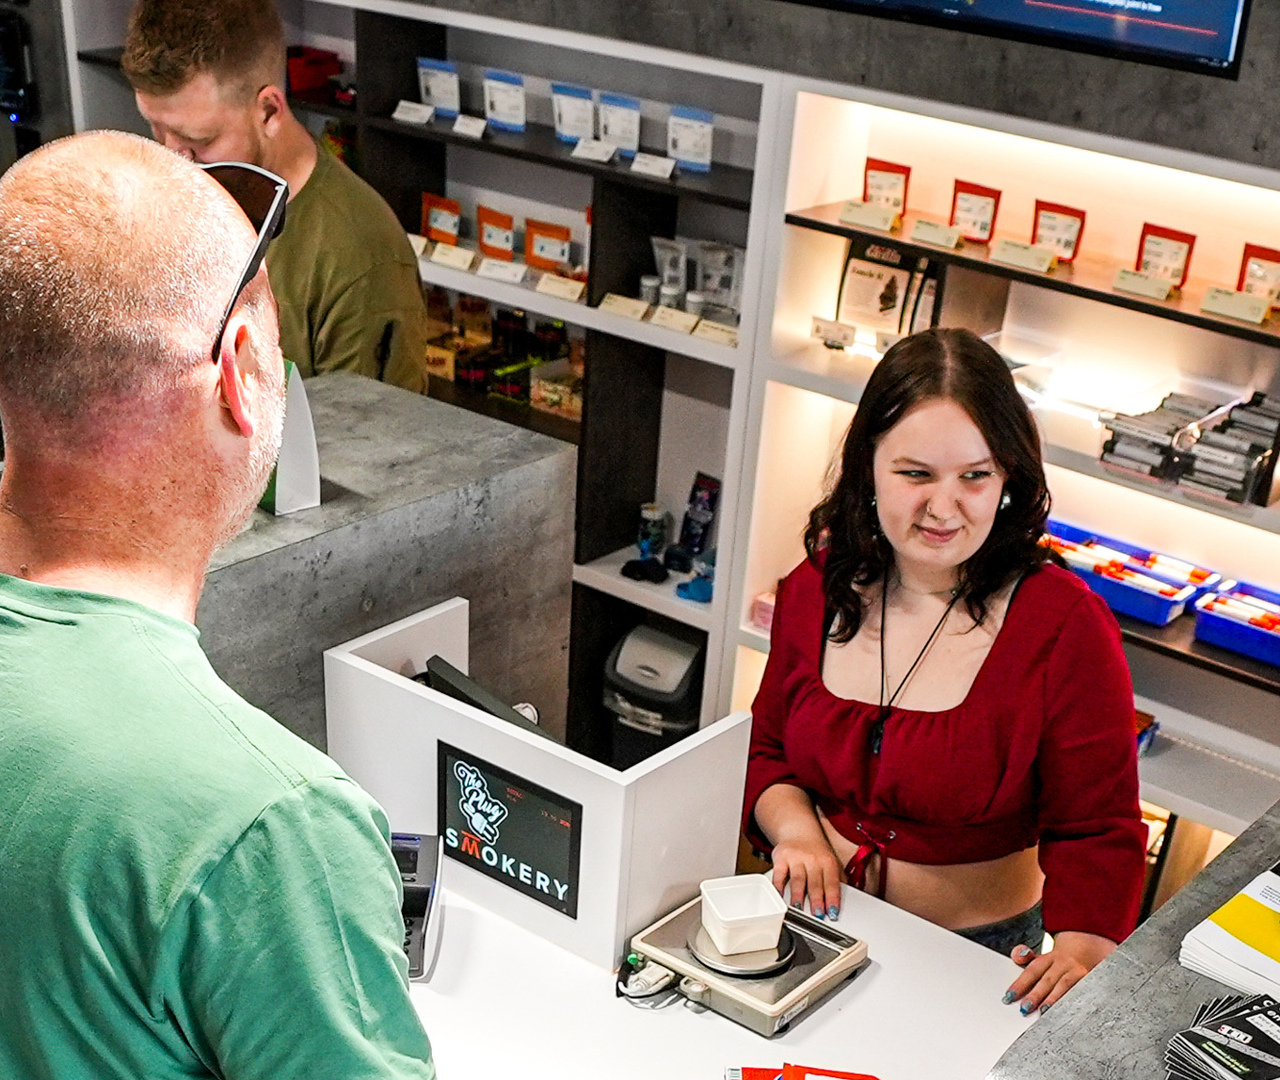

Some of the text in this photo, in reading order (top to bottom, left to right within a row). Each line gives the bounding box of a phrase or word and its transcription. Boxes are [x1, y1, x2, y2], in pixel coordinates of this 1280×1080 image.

[457, 765, 483, 788] The
[464, 787, 505, 822] Plug
[445, 828, 568, 901] SMOKERY
